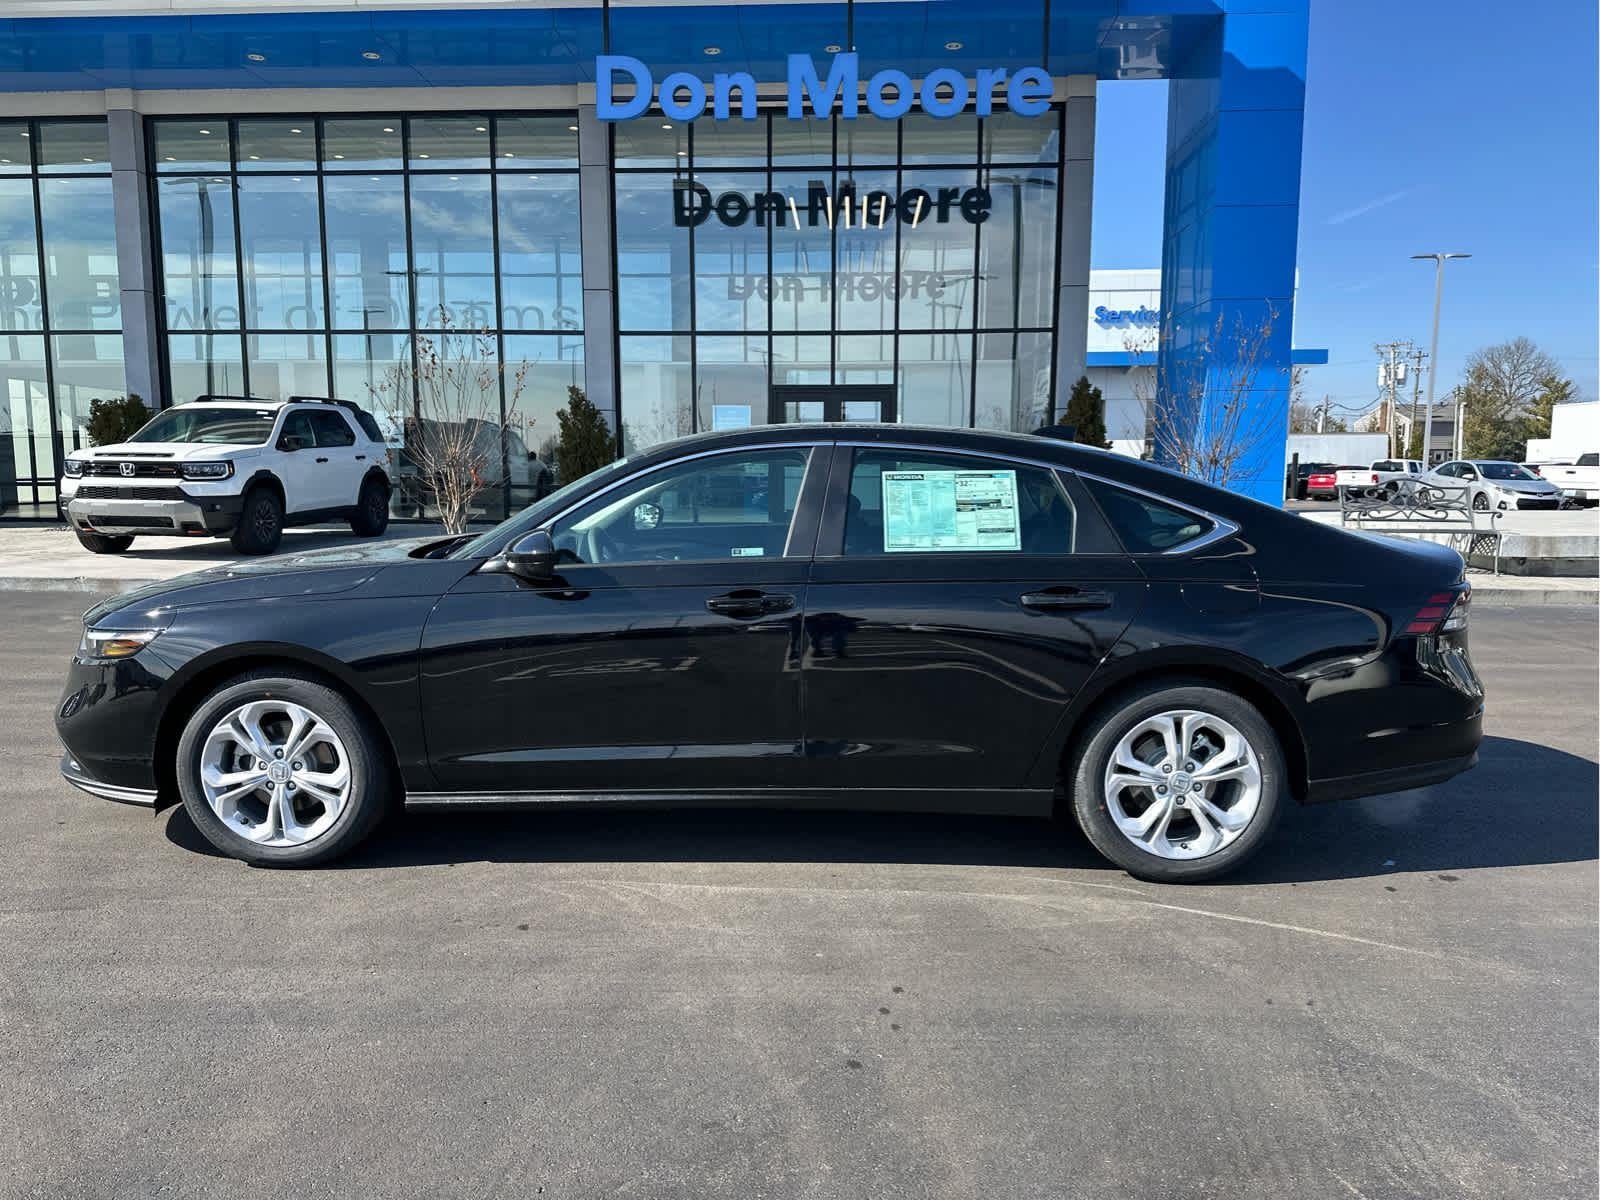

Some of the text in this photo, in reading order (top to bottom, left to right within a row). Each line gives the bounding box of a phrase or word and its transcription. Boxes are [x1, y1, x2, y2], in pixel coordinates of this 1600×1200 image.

[595, 52, 1054, 122] Don Moore
[672, 178, 993, 227] Don Moore
[727, 273, 804, 302] Don
